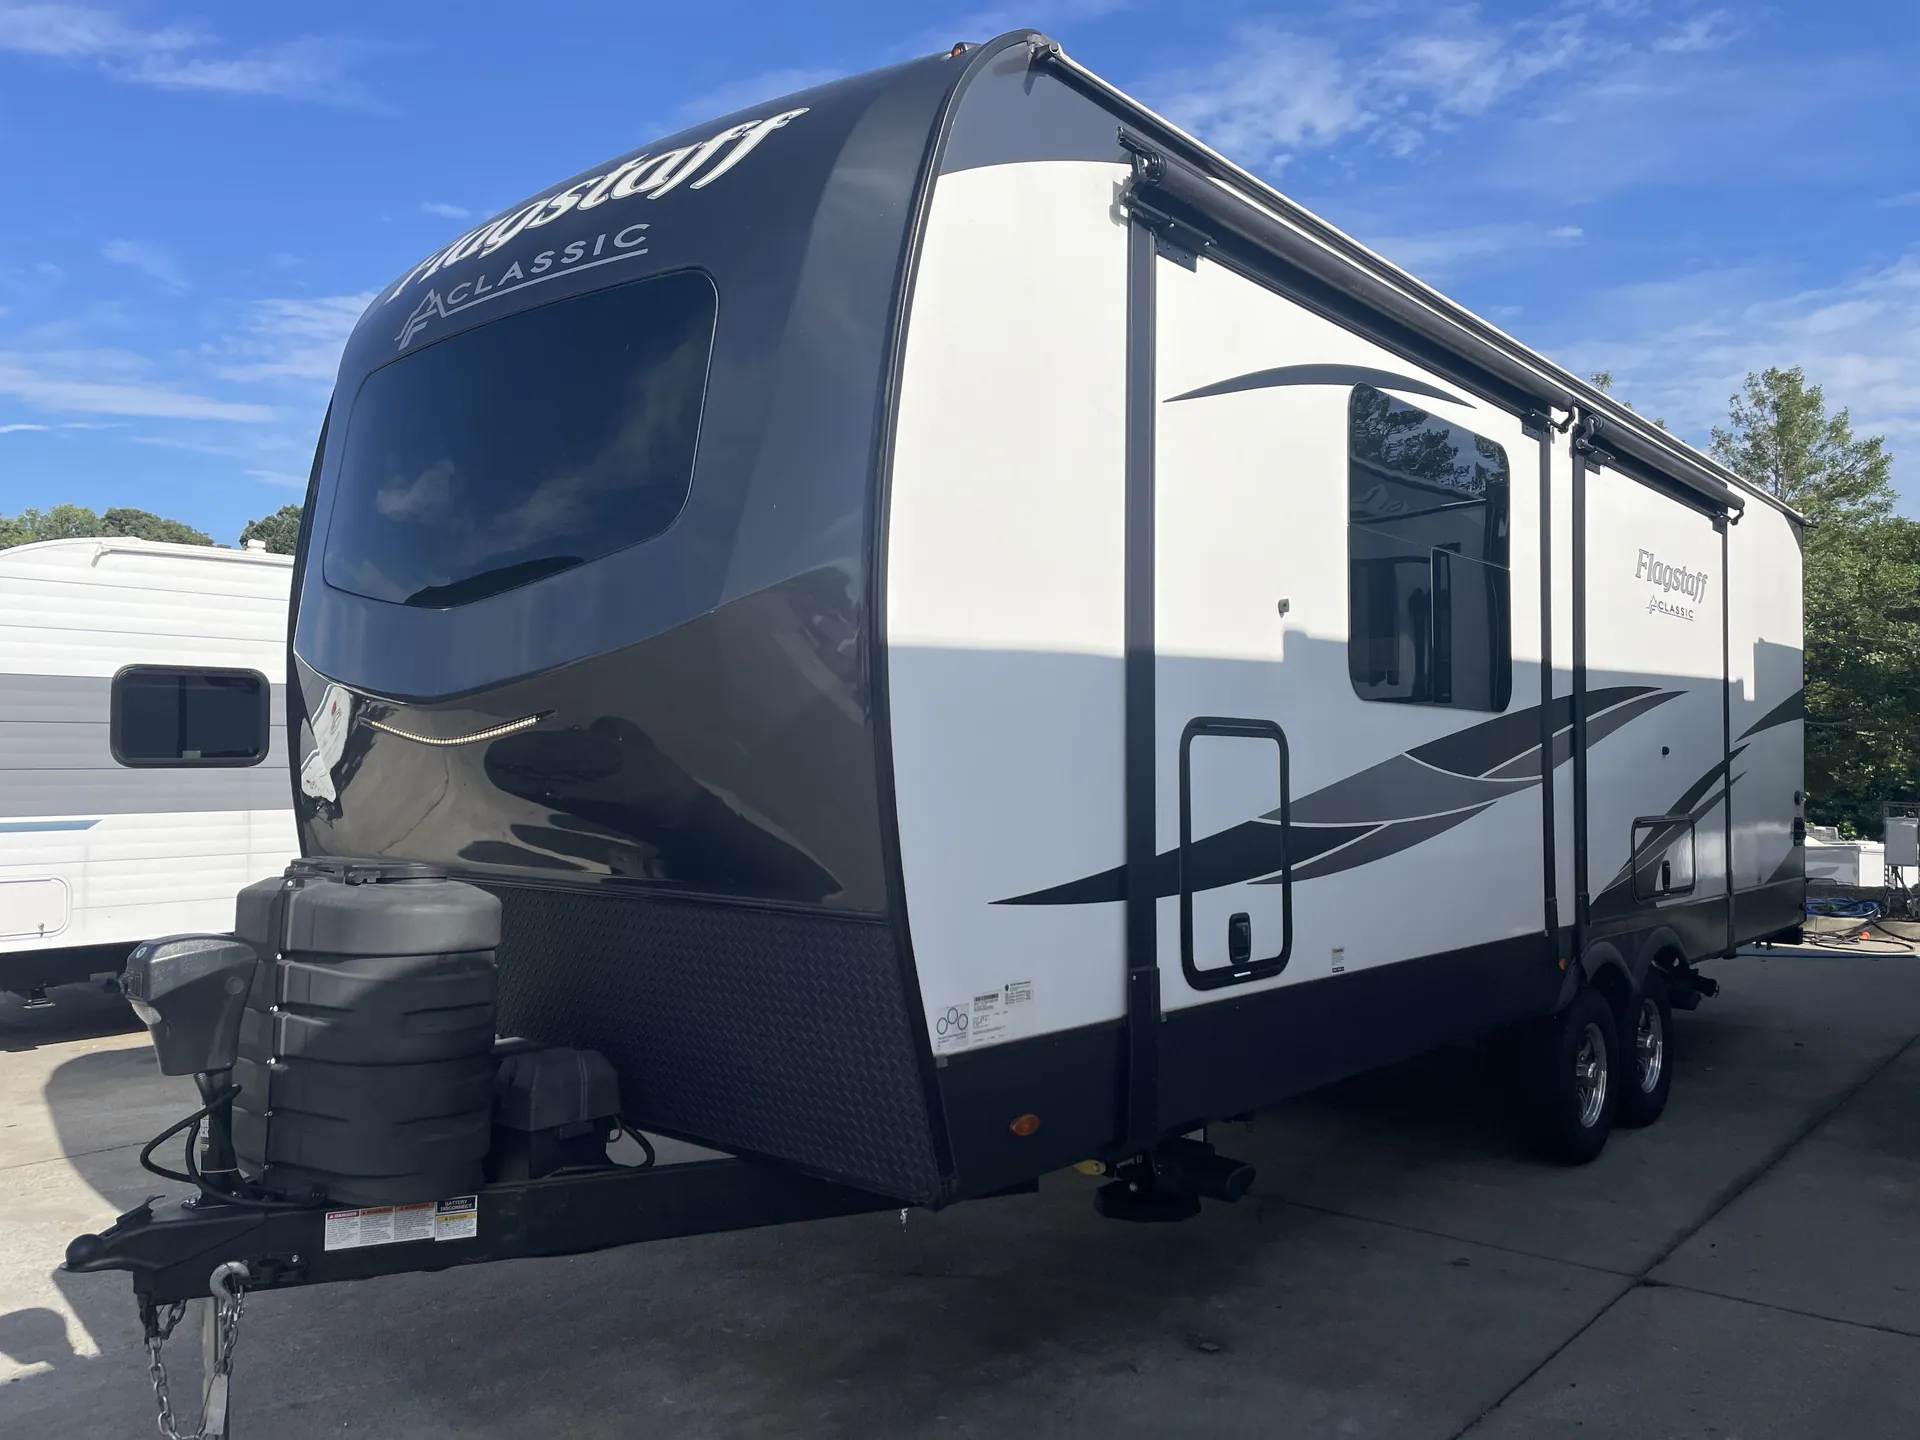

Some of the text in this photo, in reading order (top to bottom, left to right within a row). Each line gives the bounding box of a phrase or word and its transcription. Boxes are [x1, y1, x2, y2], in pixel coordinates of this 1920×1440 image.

[384, 107, 810, 305] Flagstaff
[446, 223, 650, 305] CLASSIC
[1635, 548, 1708, 604] Flagstaff
[1658, 600, 1694, 619] CLASSIC
